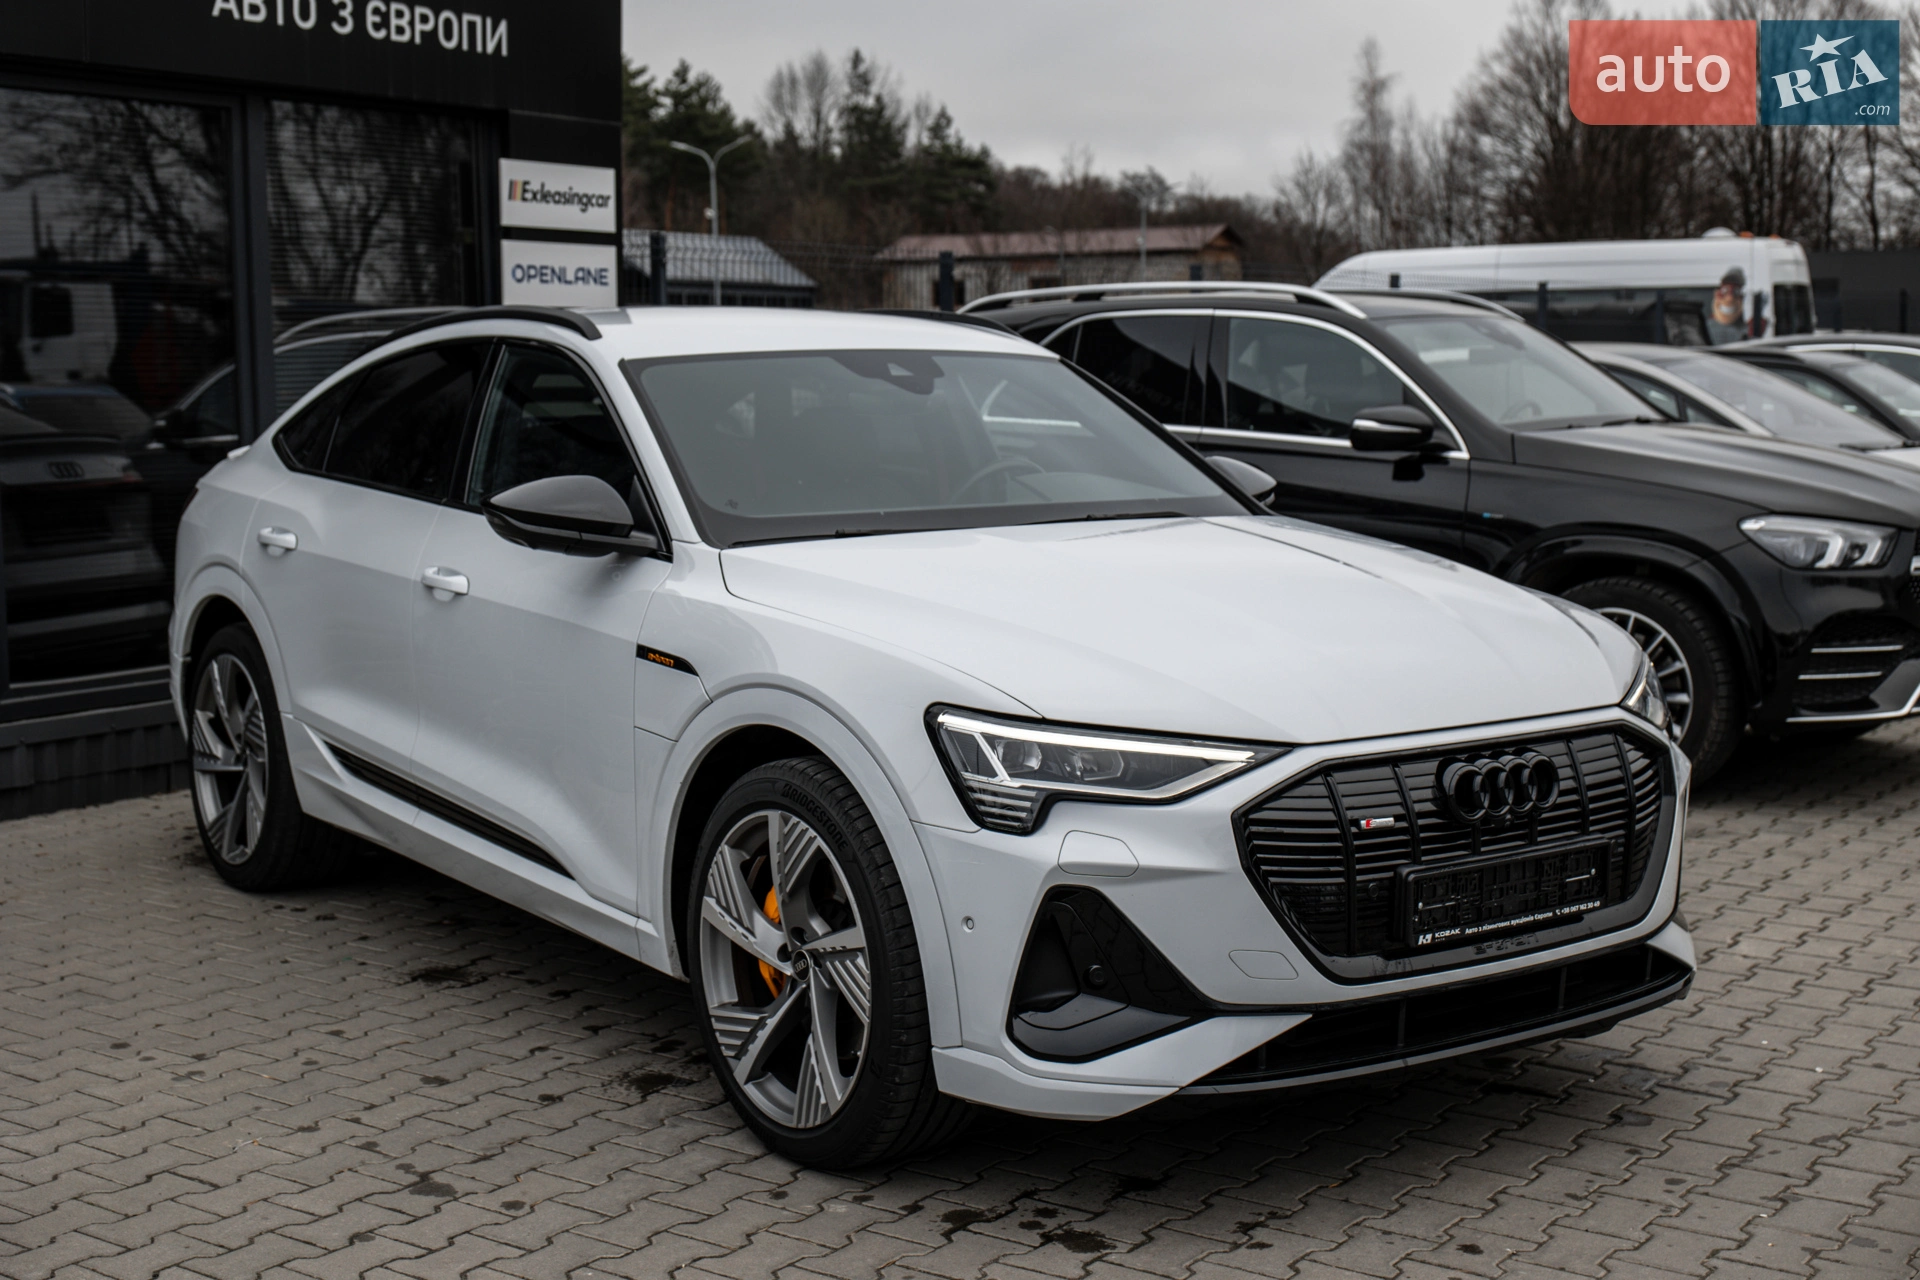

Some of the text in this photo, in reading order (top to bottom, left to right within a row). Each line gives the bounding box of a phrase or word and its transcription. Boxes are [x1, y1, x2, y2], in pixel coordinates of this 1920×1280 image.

[331, 0, 354, 35] З
[365, 0, 508, 57] ЄВРОПИ
[521, 180, 612, 213] Exleasingcar
[511, 263, 609, 287] OPENLANE
[780, 783, 849, 852] BRIDGESTONE
[1435, 928, 1461, 938] KOZAK
